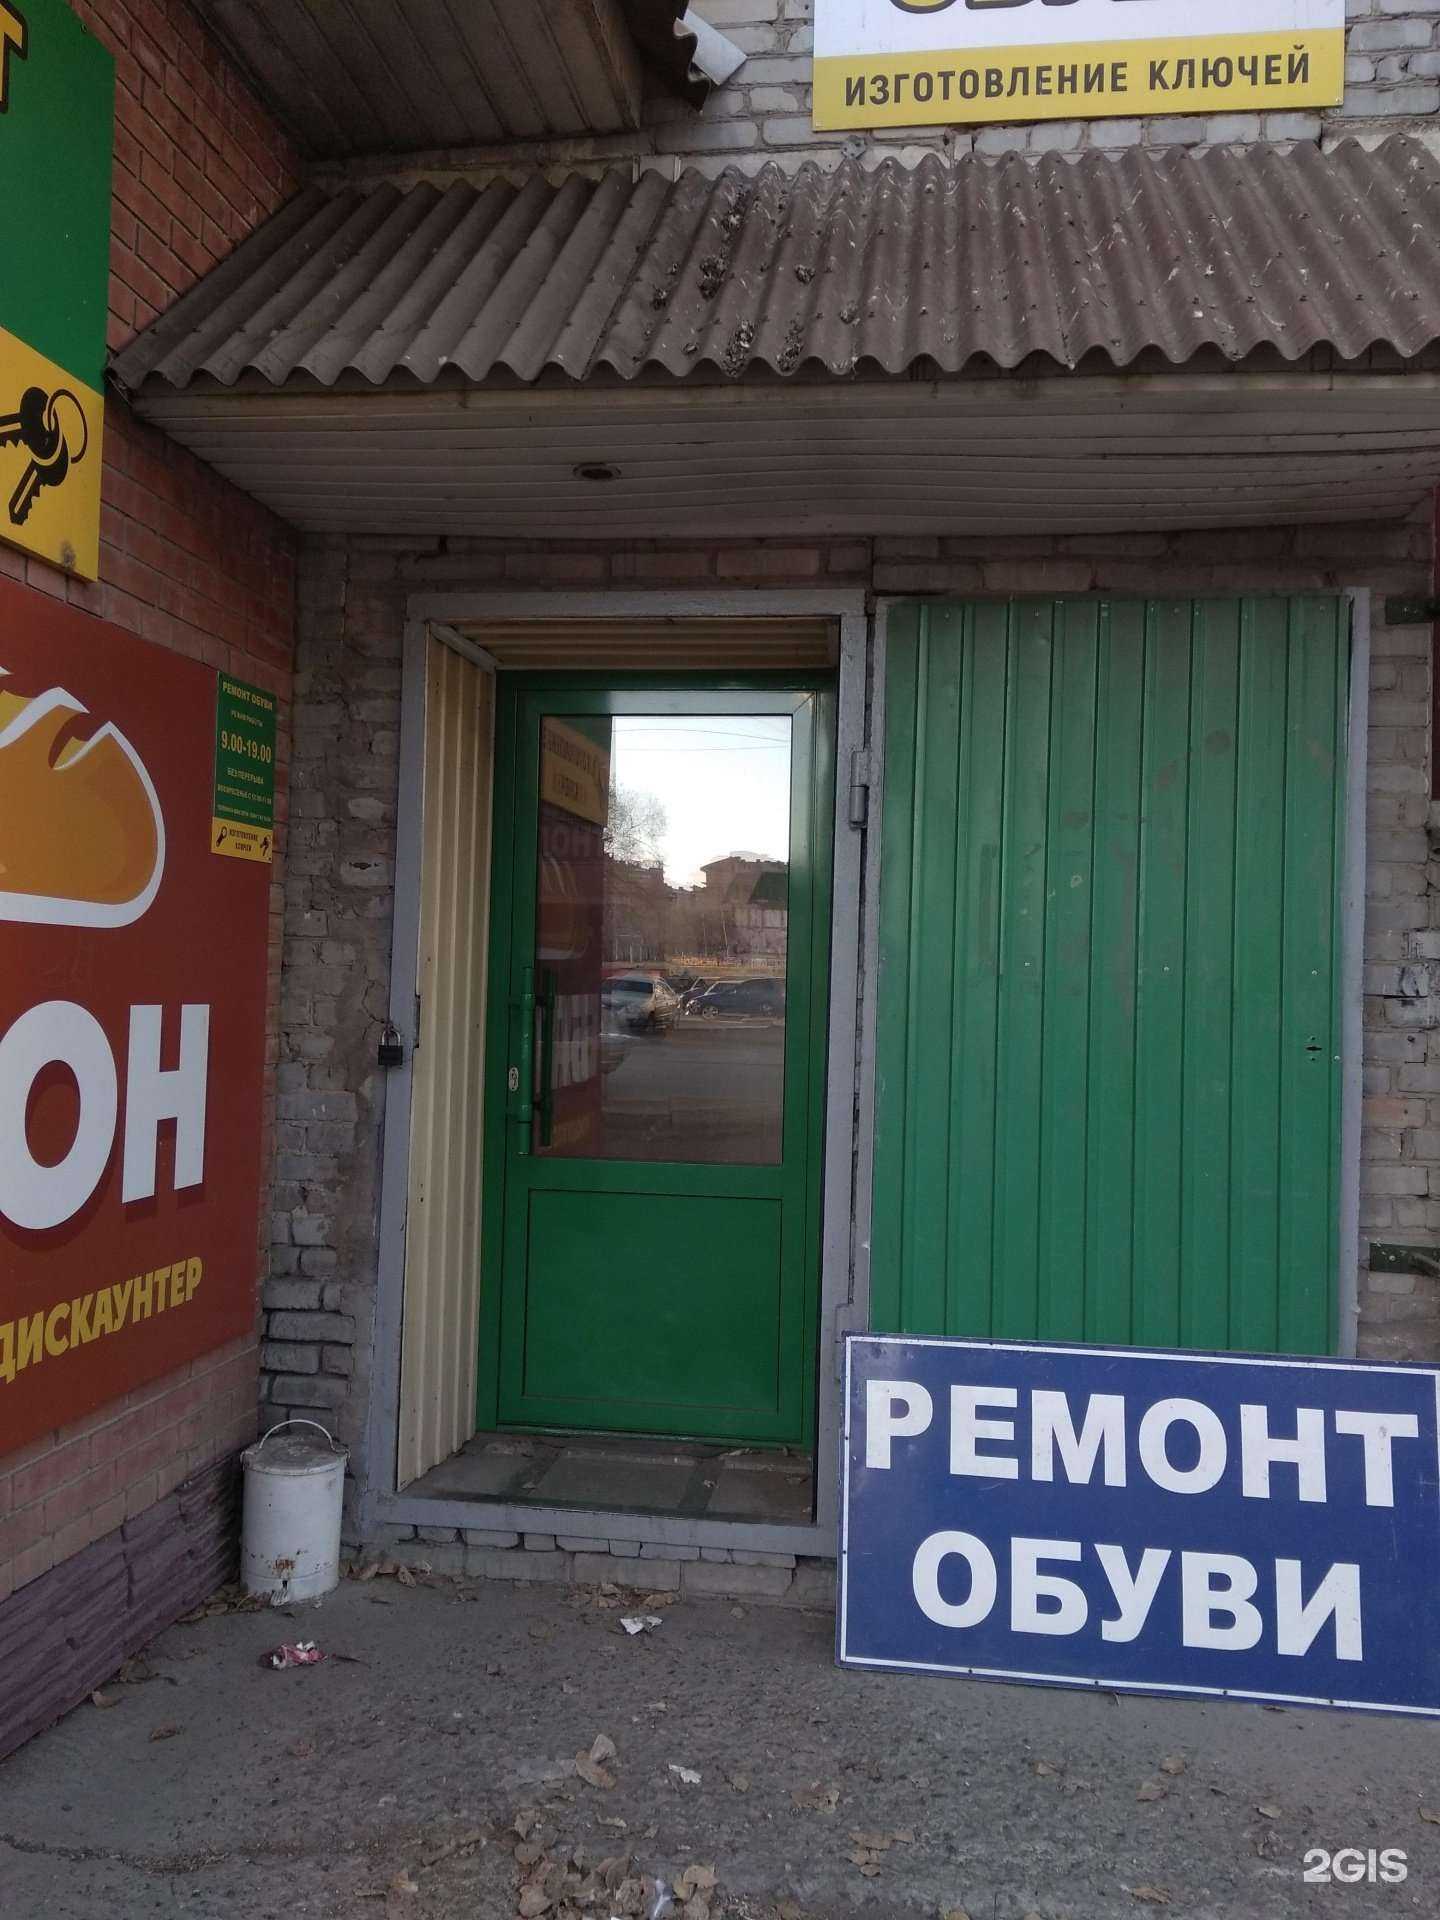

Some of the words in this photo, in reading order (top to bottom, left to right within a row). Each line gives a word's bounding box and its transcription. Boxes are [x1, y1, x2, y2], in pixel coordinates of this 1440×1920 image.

[845, 62, 1128, 107] ИЗГОТОВЛЕНИЕ
[1148, 44, 1311, 91] КЛЮЧЕЙ
[222, 681, 250, 703] РЕМОНТ
[221, 730, 272, 764] 9.00-19.00
[865, 1379, 1419, 1508] РЕМОНТ
[912, 1530, 1364, 1662] ОБУВИ
